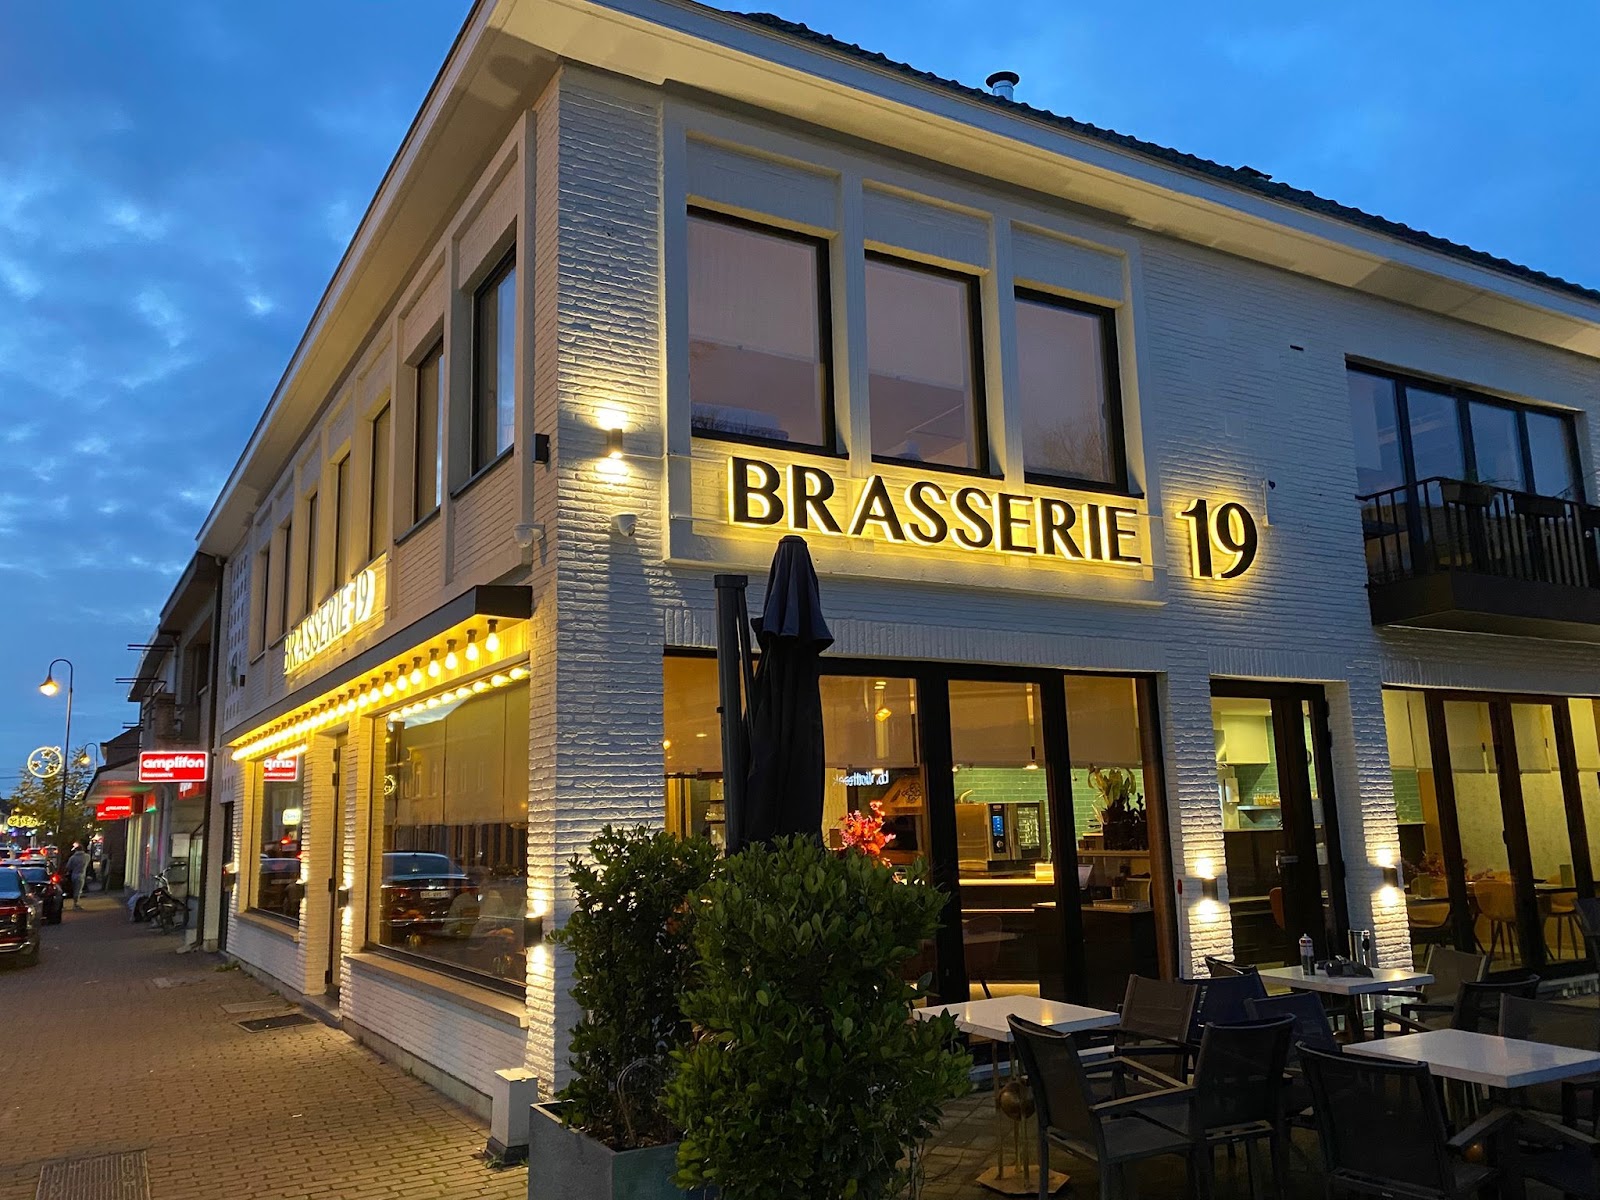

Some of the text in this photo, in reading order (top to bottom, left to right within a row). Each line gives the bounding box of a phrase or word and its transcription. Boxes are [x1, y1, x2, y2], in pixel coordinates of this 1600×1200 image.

[729, 456, 1258, 580] BRASSERIE 19
[284, 570, 372, 671] BRASSERIE 19
[142, 756, 204, 771] amplifon
